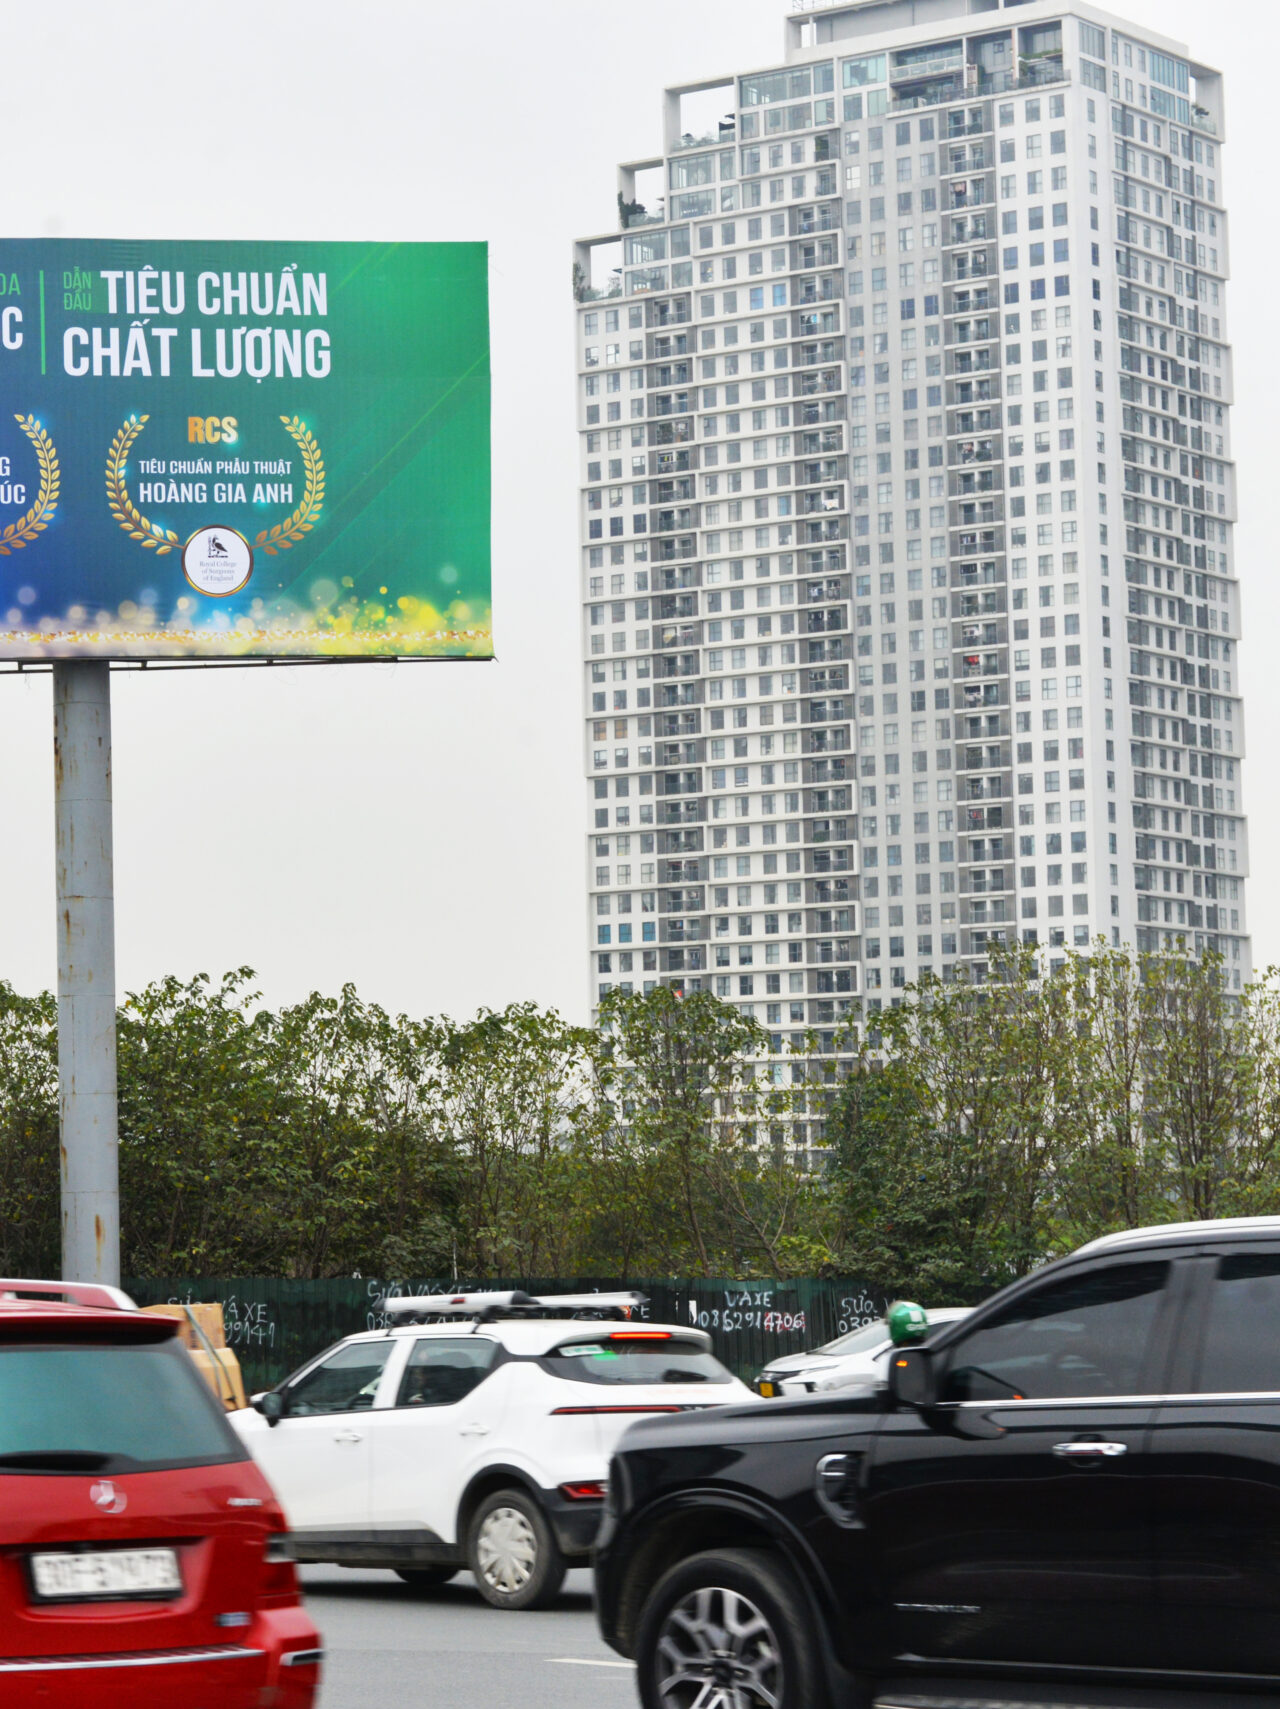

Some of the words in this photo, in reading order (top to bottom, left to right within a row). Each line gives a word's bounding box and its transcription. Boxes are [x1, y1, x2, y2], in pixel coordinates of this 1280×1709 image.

[100, 264, 186, 315] TIÊU
[197, 263, 328, 316] CHUẨN
[63, 318, 178, 377] CHẤT
[191, 326, 332, 384] LƯỢNG
[187, 416, 239, 444] RCS
[139, 458, 166, 475] TIÊU
[253, 459, 292, 475] THUẬT
[0, 480, 26, 505] ÚC
[139, 478, 207, 504] HOÀNG
[213, 482, 247, 504] GIA
[252, 483, 293, 504] ANH
